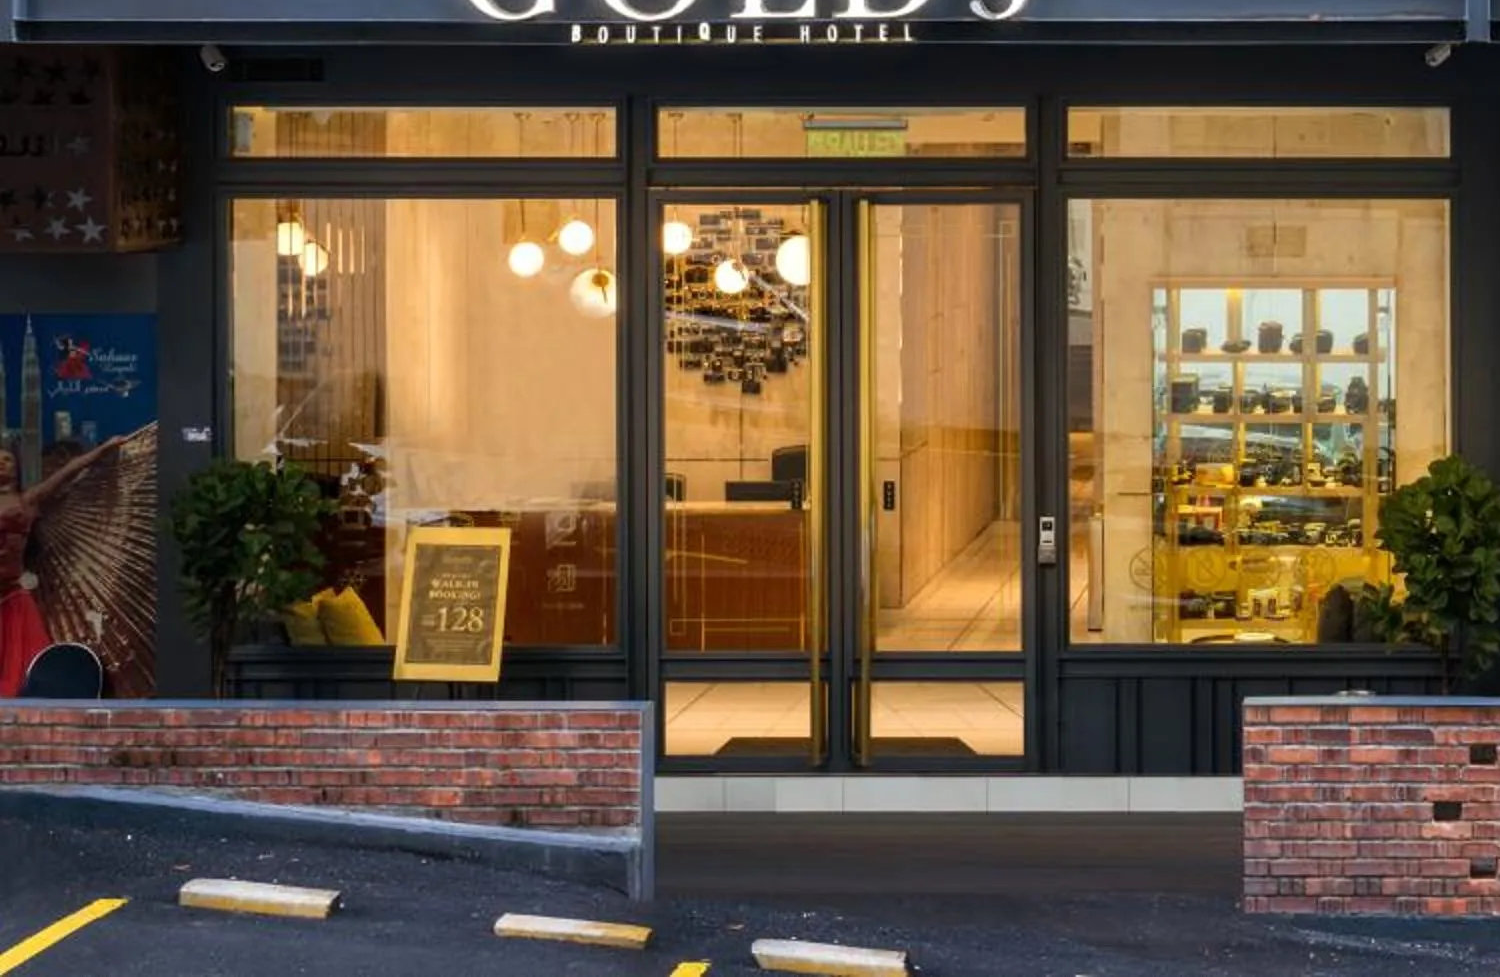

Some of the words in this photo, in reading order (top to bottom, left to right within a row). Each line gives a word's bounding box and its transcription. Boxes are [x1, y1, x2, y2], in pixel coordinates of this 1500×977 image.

[571, 22, 763, 44] BOUTIQUE
[800, 24, 914, 43] HOTEL
[438, 606, 484, 633] 128
